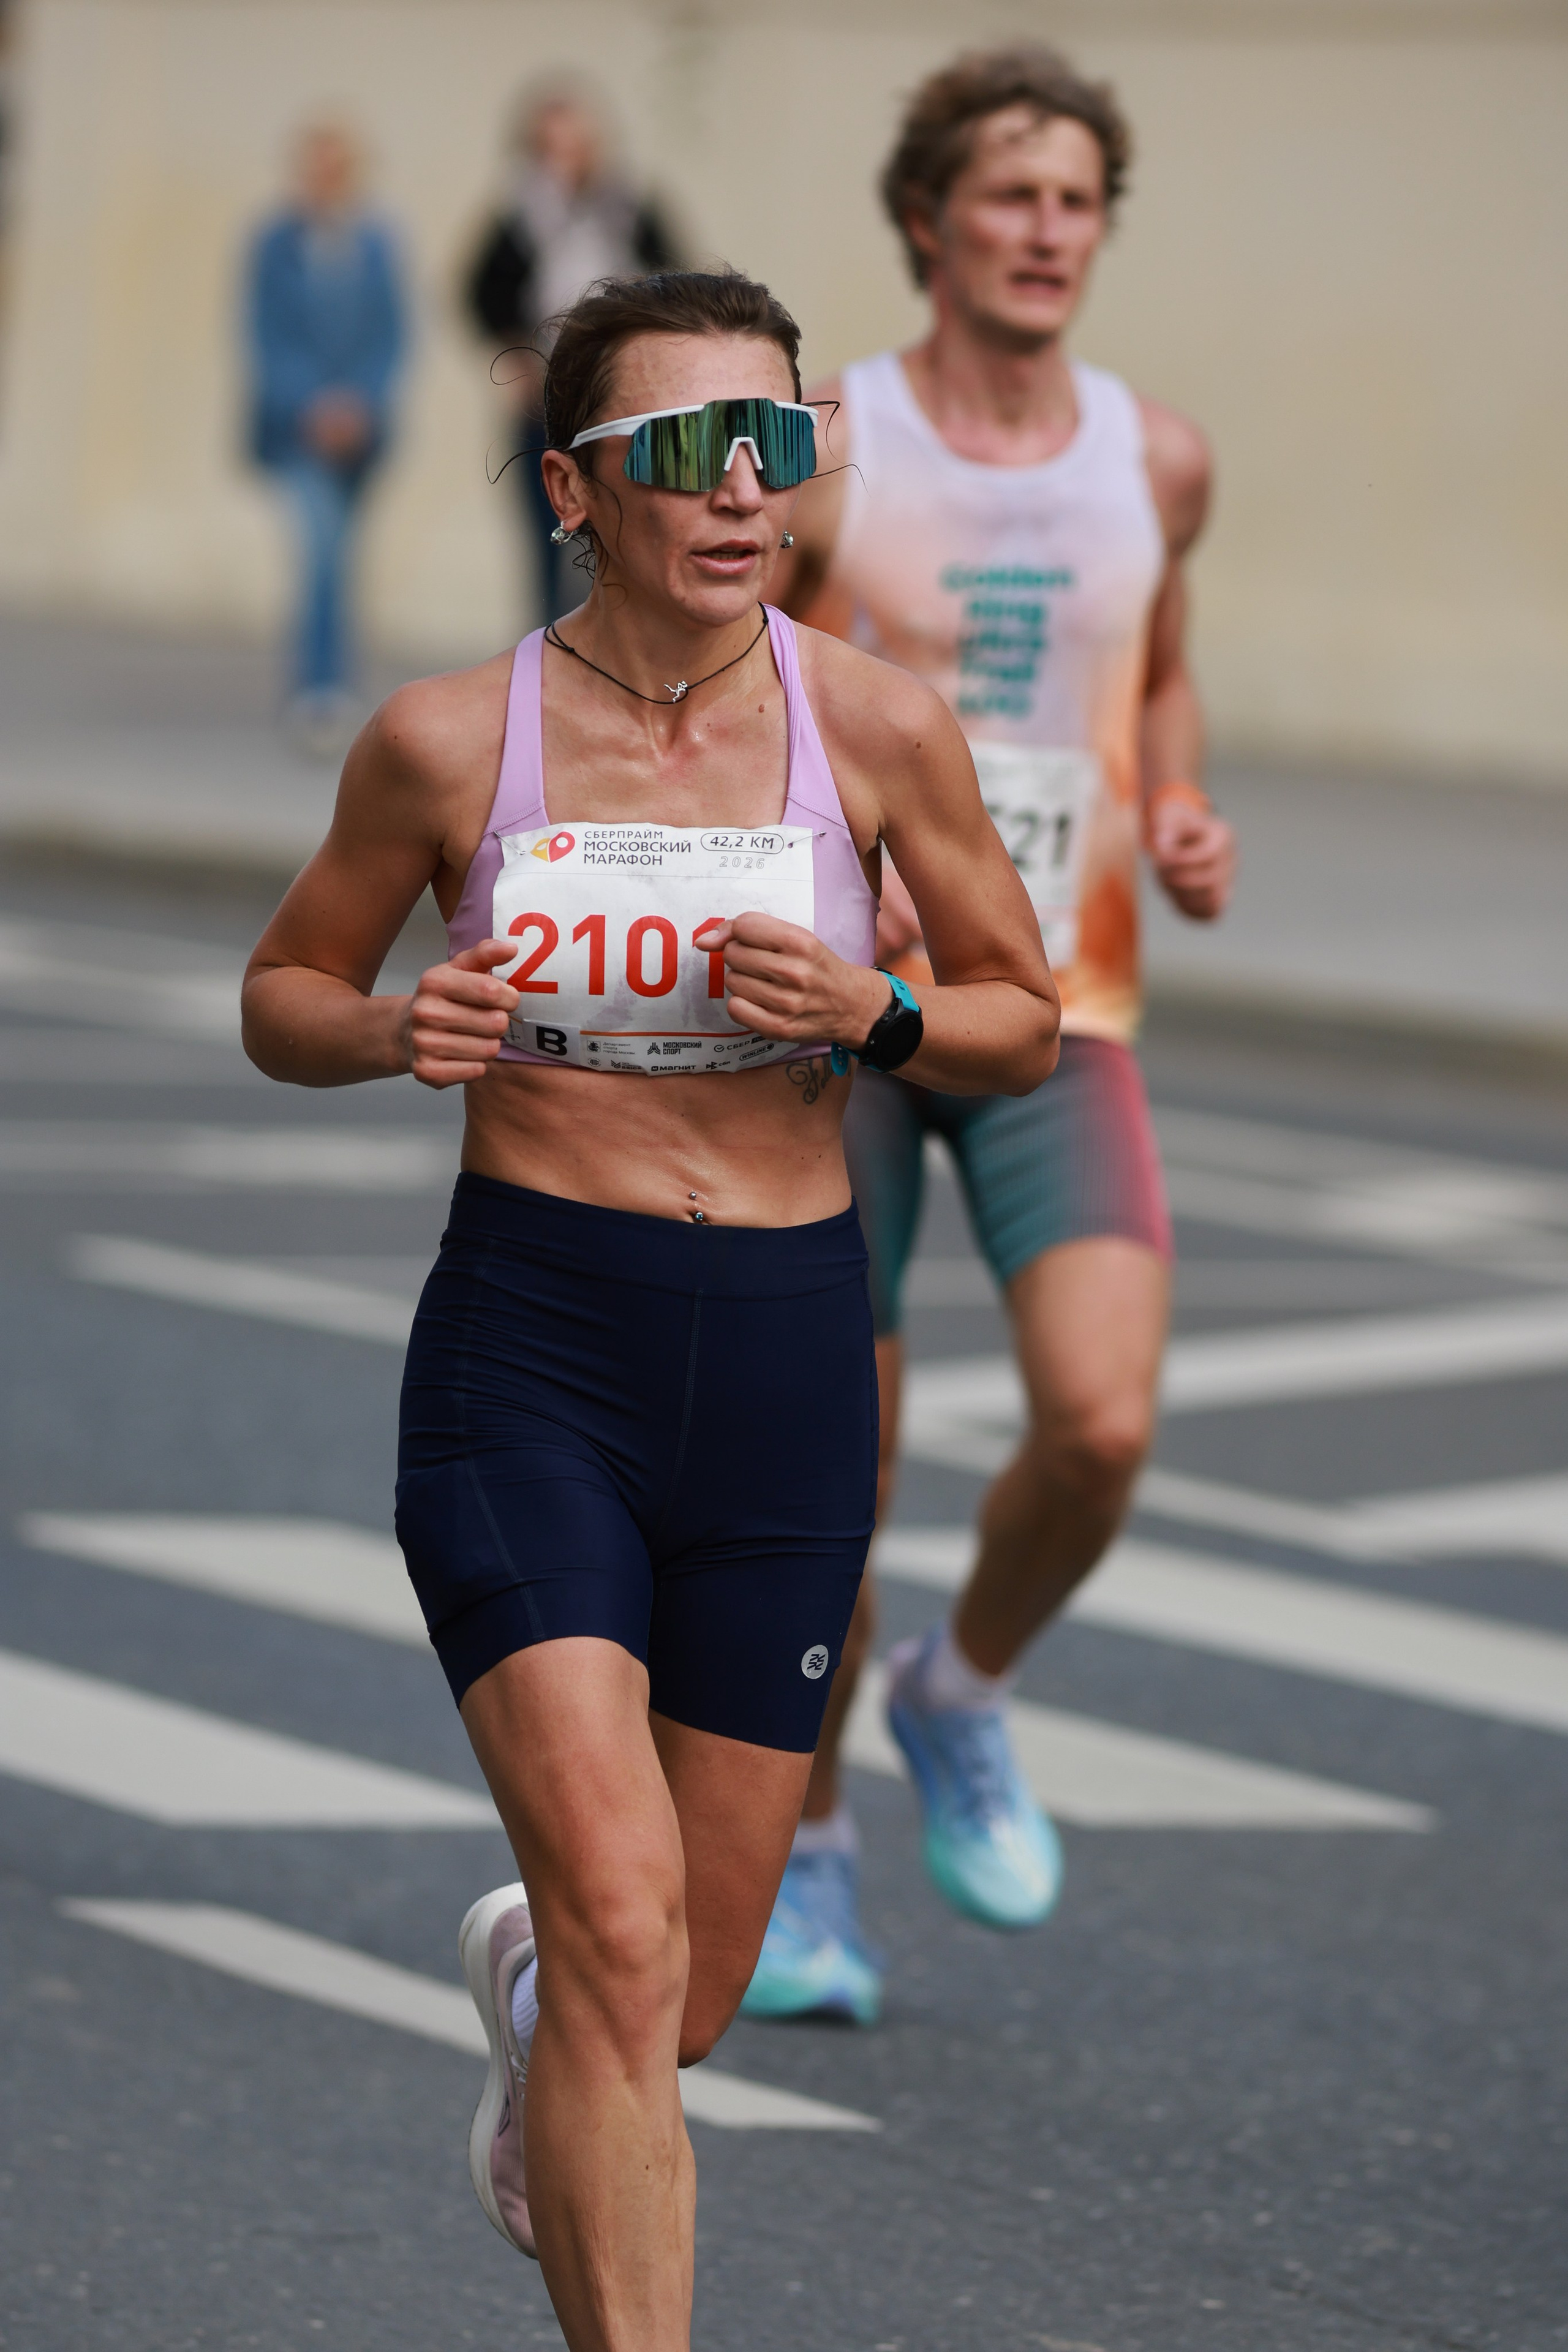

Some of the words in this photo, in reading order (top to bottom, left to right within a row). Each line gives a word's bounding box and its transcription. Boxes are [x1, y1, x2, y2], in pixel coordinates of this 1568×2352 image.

[584, 829, 663, 839] СБЕРПРАЙМ
[584, 840, 692, 853] МОСКОВСКИЙ
[710, 836, 744, 848] 42,2
[750, 836, 774, 850] КМ
[584, 854, 662, 865] МАРАФОН
[719, 856, 765, 869] 2026
[536, 1025, 567, 1056] B
[726, 1041, 751, 1050] СБЕР
[742, 1046, 767, 1060] WINLINE
